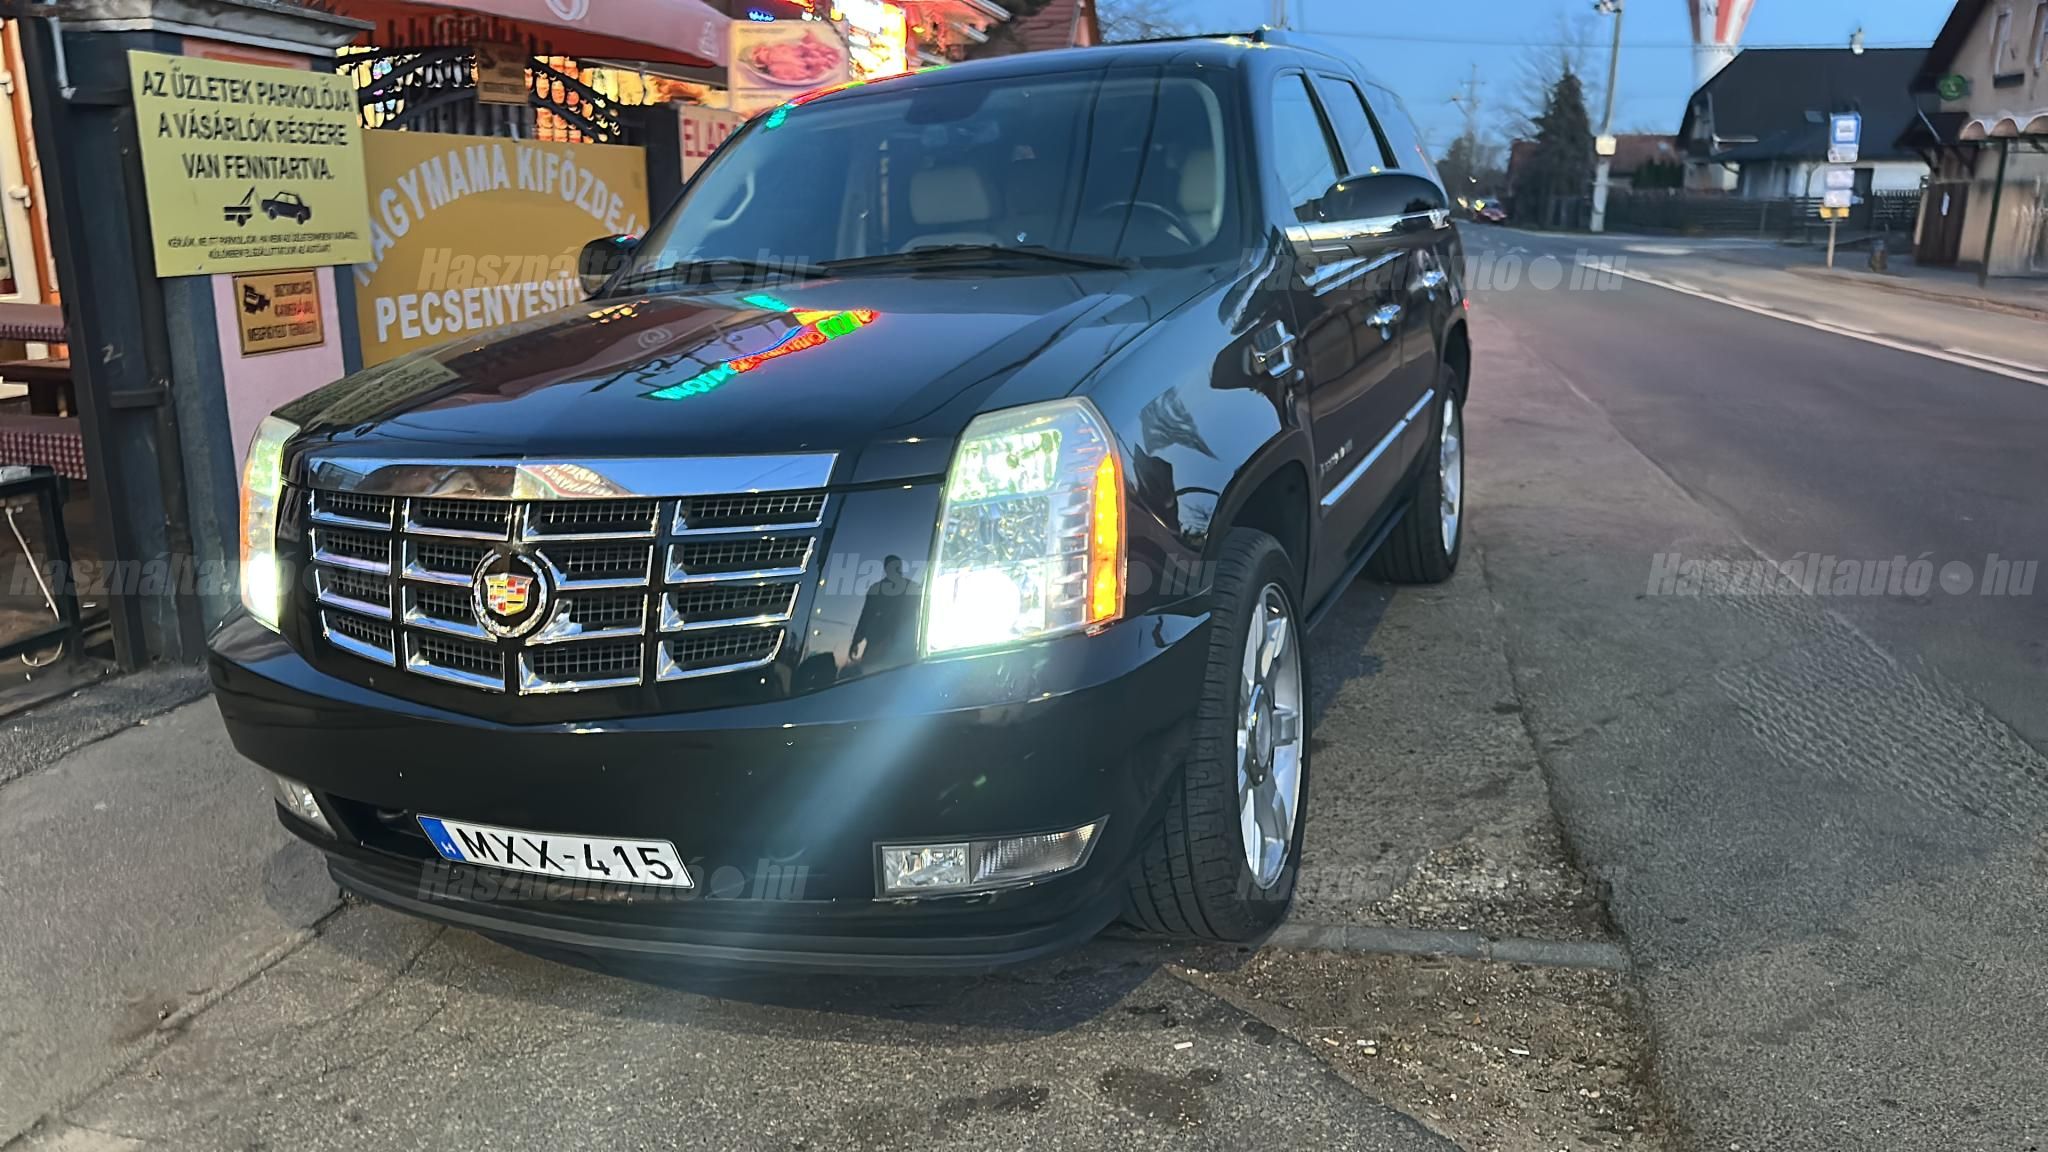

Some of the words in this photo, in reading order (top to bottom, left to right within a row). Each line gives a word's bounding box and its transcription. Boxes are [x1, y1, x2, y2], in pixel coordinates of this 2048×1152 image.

[142, 70, 169, 97] AZ
[256, 81, 353, 112] PARKOLÓJA
[158, 111, 173, 138] A
[172, 107, 273, 142] VÁSÁRLÓK
[276, 115, 348, 146] RÉSZÉRE
[181, 153, 221, 179] VAN
[440, 841, 457, 855] H
[456, 827, 674, 881] MXX-415
